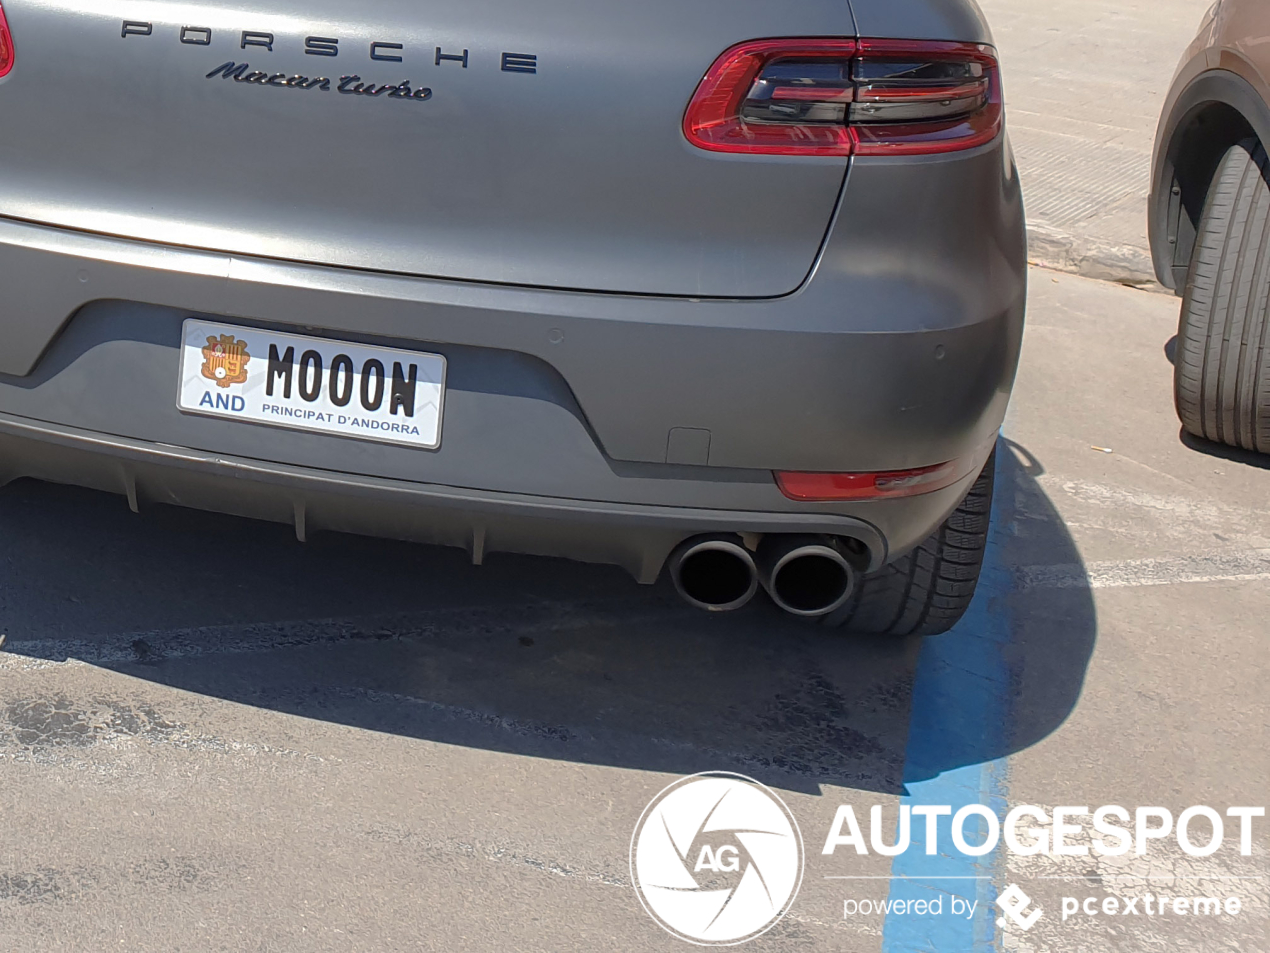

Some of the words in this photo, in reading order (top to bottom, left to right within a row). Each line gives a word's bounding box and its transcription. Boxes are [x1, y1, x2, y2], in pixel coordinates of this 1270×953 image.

[121, 20, 538, 75] PORSCHE
[206, 61, 330, 91] Macan
[336, 74, 433, 102] turbo
[199, 390, 246, 412] AND
[262, 403, 334, 424] PRINCIPAT
[338, 414, 420, 436] D'ANDORRA
